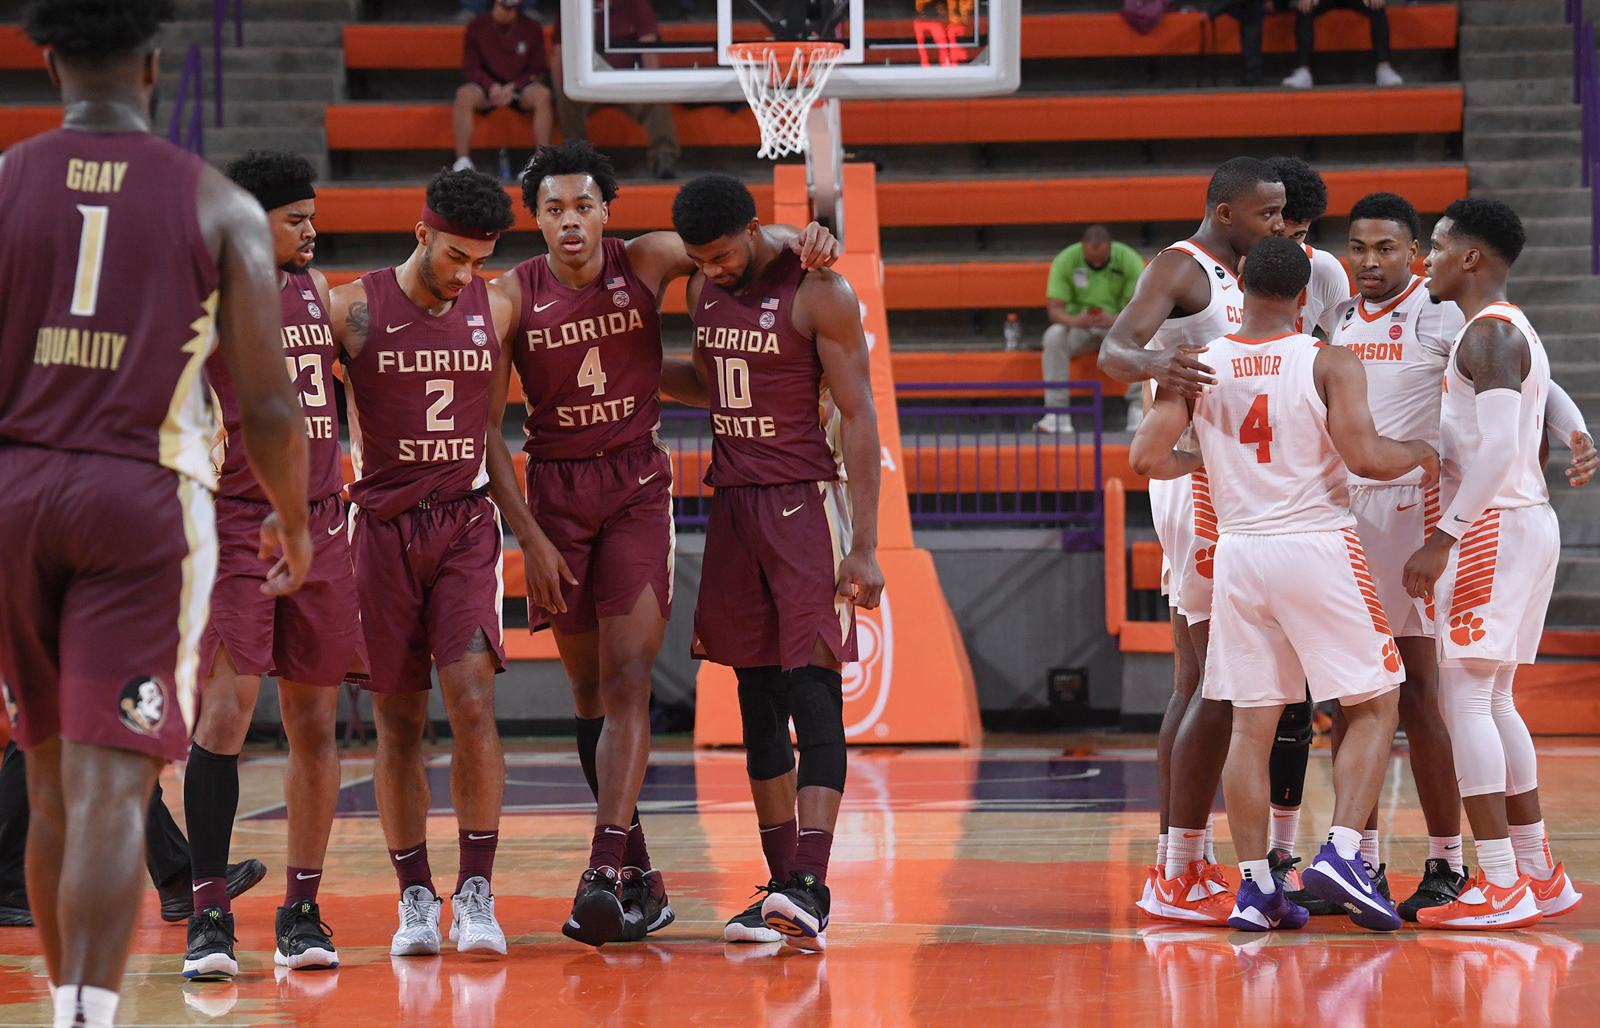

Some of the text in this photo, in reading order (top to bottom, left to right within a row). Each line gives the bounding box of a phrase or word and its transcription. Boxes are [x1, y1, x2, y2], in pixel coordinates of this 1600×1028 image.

[66, 158, 129, 193] GRAY
[70, 203, 109, 317] 1
[281, 324, 334, 349] RIDA
[526, 308, 644, 352] FLORIDA
[697, 326, 780, 355] FLORIDA
[376, 349, 492, 373] FLORIDA
[1231, 355, 1282, 379] HONOR
[1346, 343, 1403, 361] MSON
[577, 346, 607, 397] 4
[713, 356, 752, 409] 10
[425, 379, 454, 431] 2
[556, 396, 635, 427] STATE
[304, 416, 332, 439] ATE
[712, 413, 776, 438] STATE
[1239, 394, 1273, 464] 4
[398, 438, 475, 461] STATE
